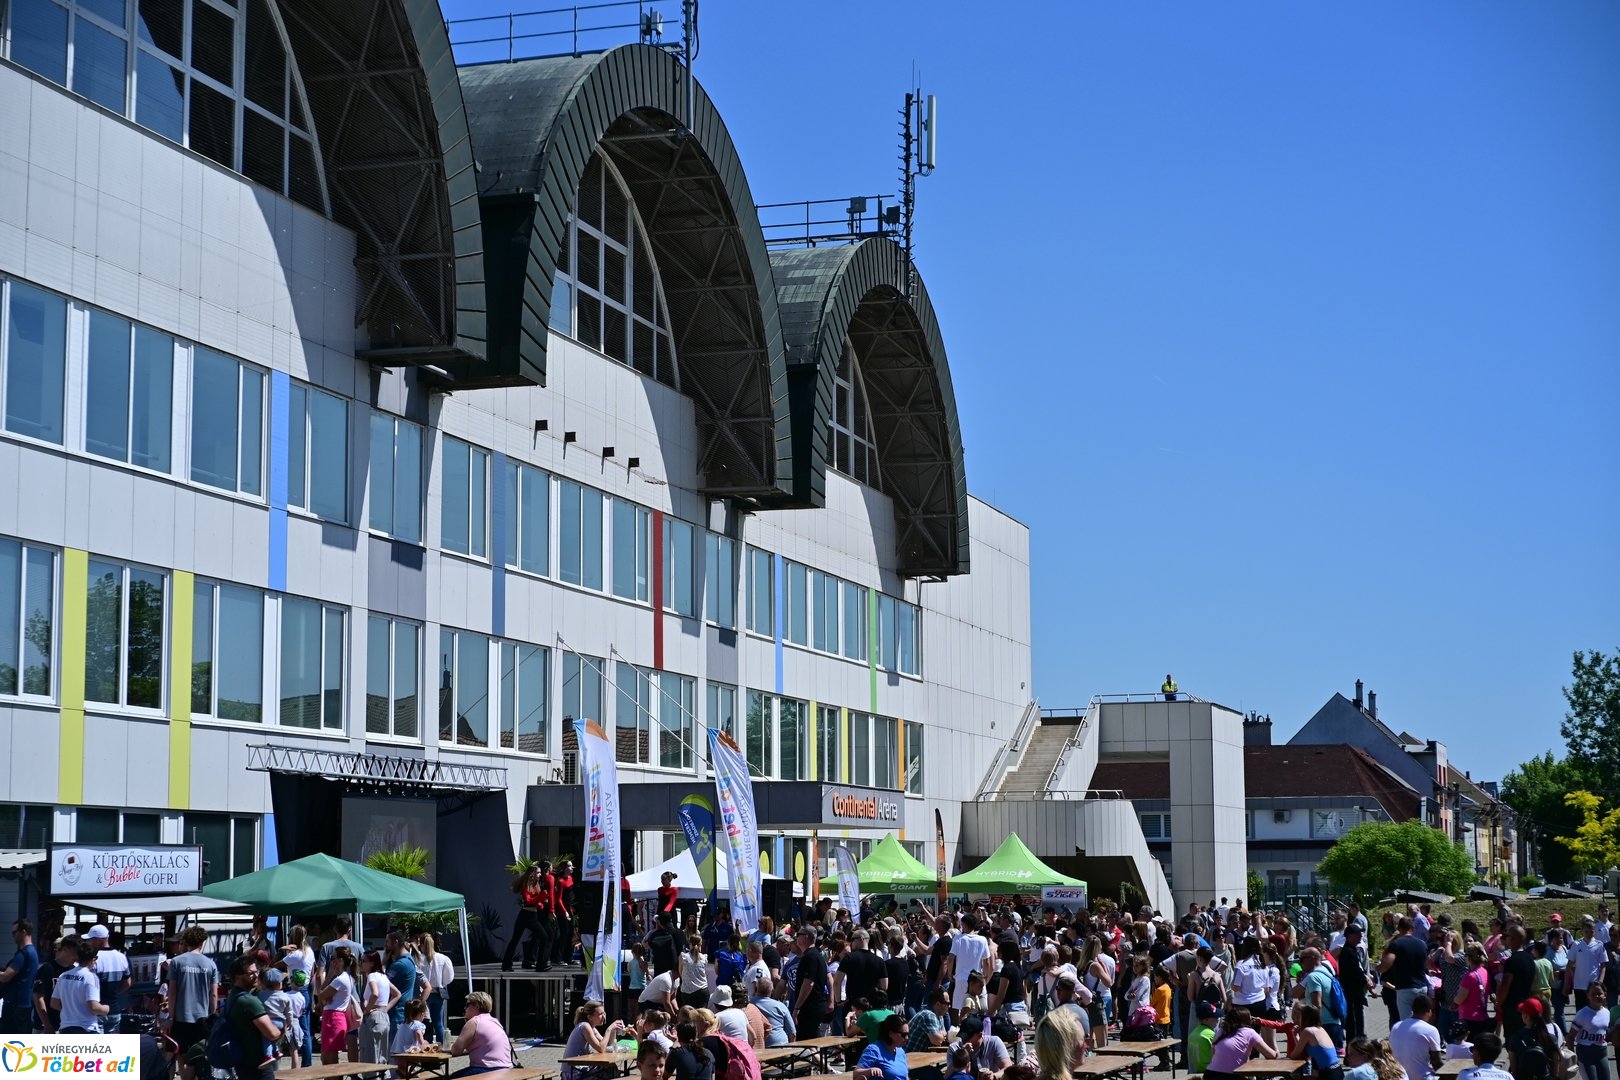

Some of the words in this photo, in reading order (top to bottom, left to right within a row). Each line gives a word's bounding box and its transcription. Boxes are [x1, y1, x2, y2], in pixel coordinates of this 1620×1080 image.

[832, 792, 878, 820] Continental
[92, 851, 190, 869] KÜRTŐSKALÁCS
[96, 873, 102, 884] &
[104, 864, 141, 888] Bubble
[143, 872, 178, 885] GOFRI
[755, 968, 763, 979] 5
